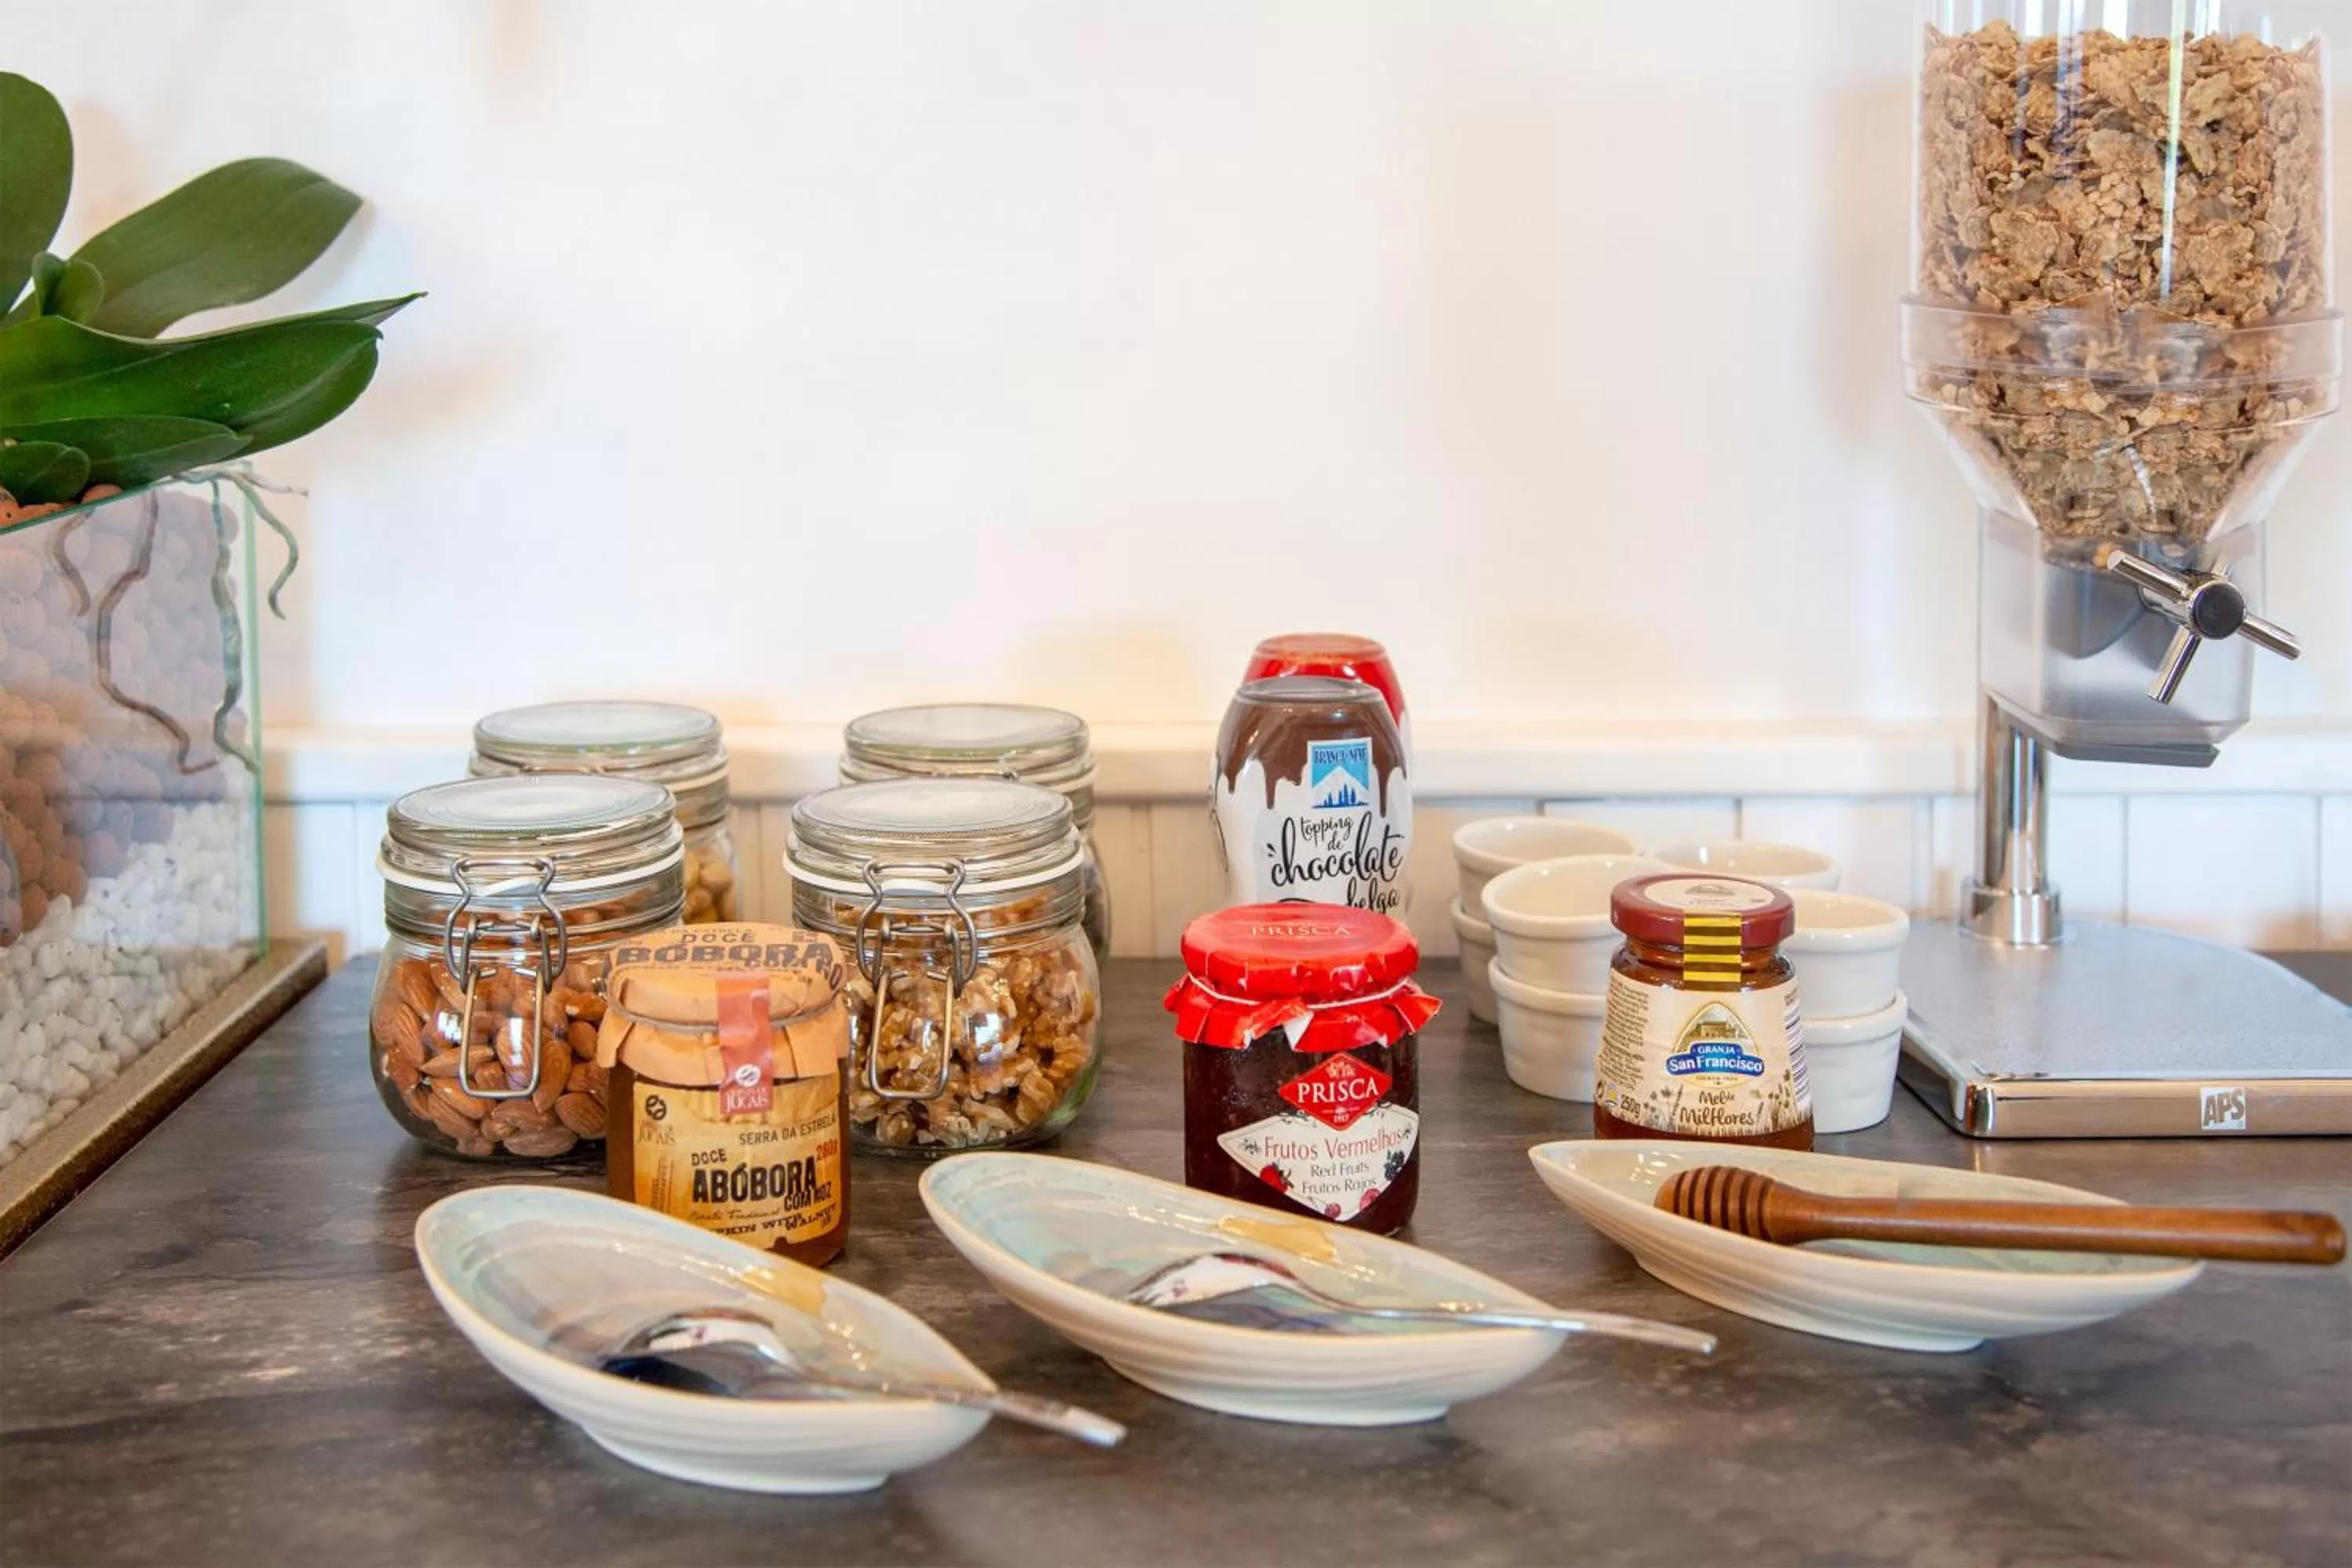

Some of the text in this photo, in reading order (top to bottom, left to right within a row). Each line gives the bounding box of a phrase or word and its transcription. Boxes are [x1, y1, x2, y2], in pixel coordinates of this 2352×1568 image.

[1300, 817, 1353, 847] topping
[1327, 831, 1343, 851] de
[1272, 811, 1404, 887] chocolate
[1347, 877, 1400, 914] belga
[681, 933, 755, 943] DOCE
[1251, 926, 1351, 936] PRISCA
[1697, 1045, 1736, 1054] GRANJA
[1298, 1076, 1379, 1103] PRISCA
[1699, 1090, 1726, 1105] Mel
[2202, 1087, 2245, 1126] APS
[739, 1112, 836, 1145] SERRA DA ESTRELA
[1265, 1128, 1403, 1160] Frutos Vermelhos
[691, 1148, 728, 1166] DOCE
[691, 1156, 817, 1203] ABÓBORA
[1311, 1162, 1370, 1178] Red Fruits
[1302, 1177, 1377, 1194] Frutos Rojos
[785, 1190, 811, 1211] COM
